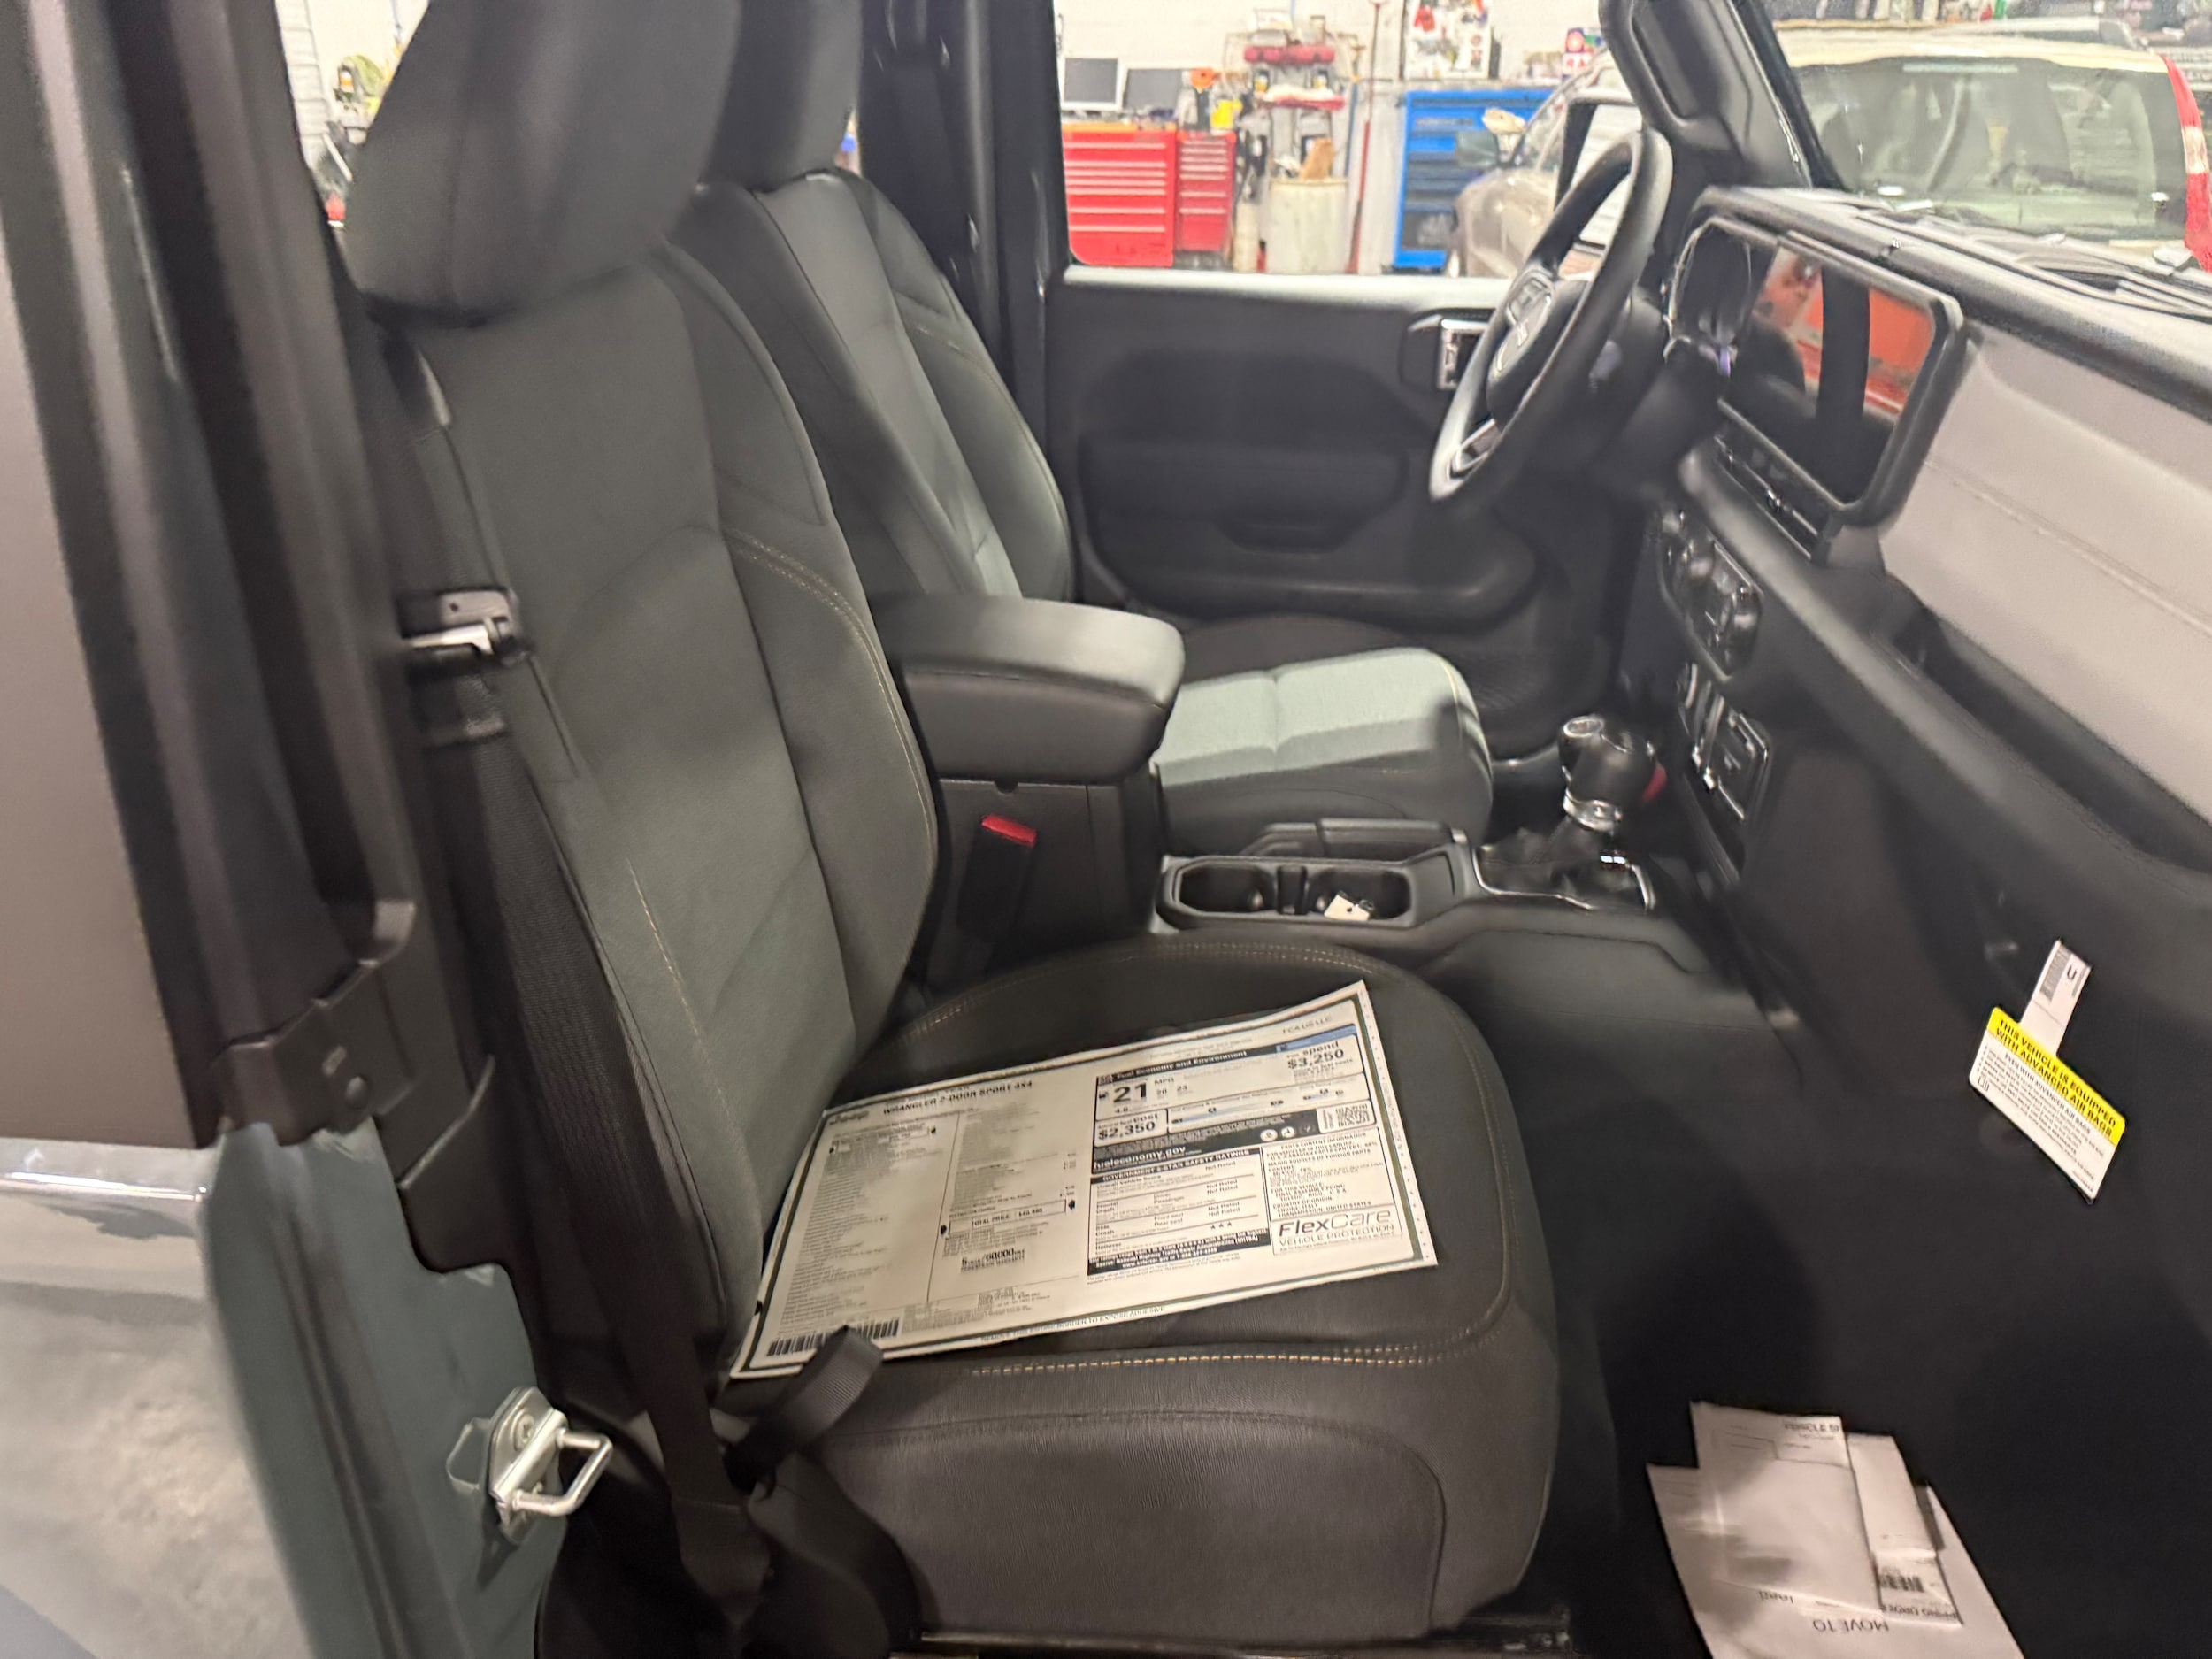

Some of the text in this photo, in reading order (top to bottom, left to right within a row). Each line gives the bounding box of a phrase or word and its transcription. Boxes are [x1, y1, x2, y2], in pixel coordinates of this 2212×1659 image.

[2067, 964, 2077, 980] U
[1287, 1048, 1345, 1070] $3,250
[1302, 1040, 1340, 1056] spend
[1117, 1071, 1135, 1079] Fuel
[1136, 1063, 1174, 1076] Economy
[1194, 1049, 1248, 1063] Environment
[2000, 1019, 2116, 1127] THIS VEHICLE IS EQUIPPED
[1113, 1082, 1148, 1103] 21
[1996, 1027, 2113, 1137] WITH ADVANCED AIR BAGS
[2004, 1052, 2091, 1134] EVEN WITH ADVANCED AIR BAGS
[883, 1098, 938, 1115] WRANGLER
[979, 1085, 1012, 1098] SPORT
[1098, 1121, 1156, 1141] $2,350
[1094, 1146, 1187, 1170] fueleconomy.gov
[1102, 1165, 1155, 1182] GOVERNMENT
[1184, 1156, 1215, 1167] SAFETY
[1215, 1149, 1250, 1161] RATINGS
[1325, 1151, 1352, 1160] FOREIGN
[1278, 1210, 1392, 1237] FlexCare
[1279, 1232, 1326, 1247] VEHICLE
[1326, 1224, 1395, 1240] PROTECTION
[1087, 1316, 1099, 1325] TO
[1129, 1305, 1166, 1317] ADHESIVE
[1812, 1618, 1890, 1633] MOVE TO
